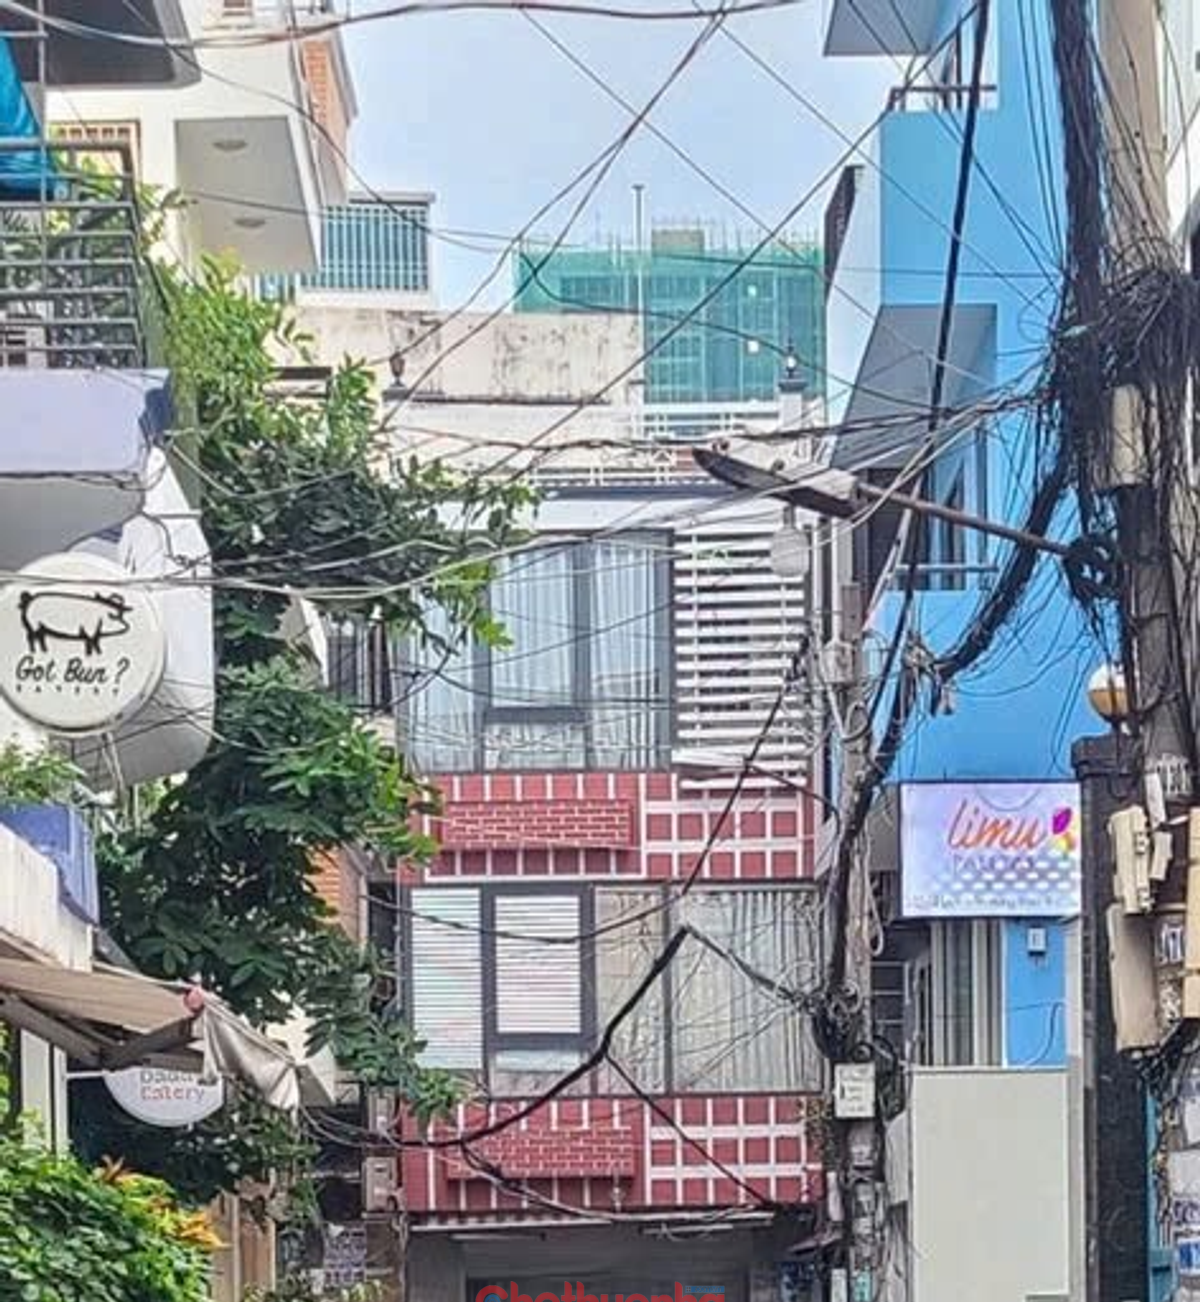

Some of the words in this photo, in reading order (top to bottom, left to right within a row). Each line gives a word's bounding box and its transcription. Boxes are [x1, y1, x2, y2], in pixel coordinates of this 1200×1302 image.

[16, 655, 57, 682] Got
[64, 656, 109, 684] Bun
[948, 799, 1047, 850] limu
[141, 1086, 205, 1103] Eatery
